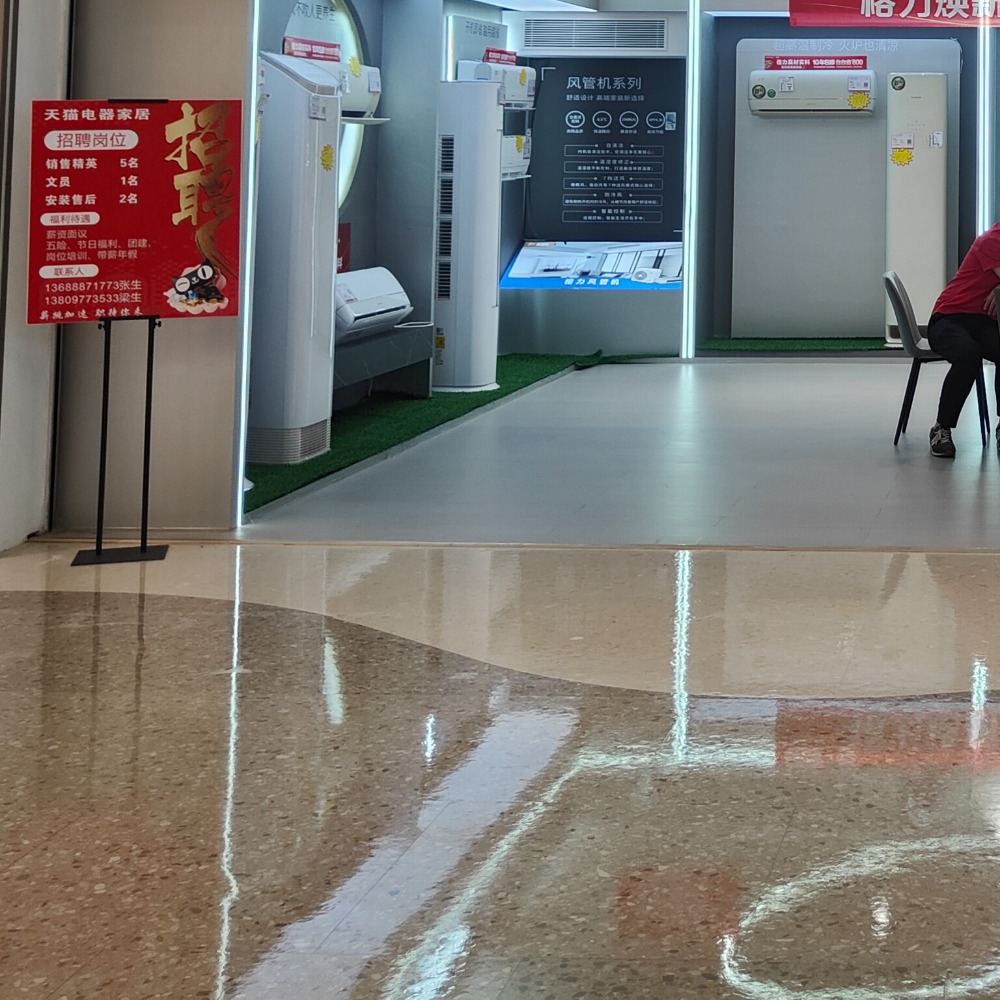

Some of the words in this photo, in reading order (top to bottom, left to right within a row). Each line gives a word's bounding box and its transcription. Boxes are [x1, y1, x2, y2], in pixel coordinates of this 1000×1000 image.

[566, 76, 642, 90] 风管机系列
[44, 108, 151, 121] 天猫电器家居
[57, 132, 127, 148] 招聘岗位
[46, 158, 97, 170] 销售精英
[120, 157, 139, 169] 5名
[45, 176, 70, 188] 文员
[120, 175, 138, 187] 1名
[45, 194, 97, 206] 安装售后
[119, 193, 138, 205] 2名
[50, 213, 91, 224] 福利待遇
[46, 229, 87, 239] 薪资面议
[46, 250, 138, 261] 岗位培训、带薪年假
[53, 267, 84, 276] 联系人
[45, 280, 142, 292] 13688871773张生
[45, 292, 142, 305] 13809773533梁生
